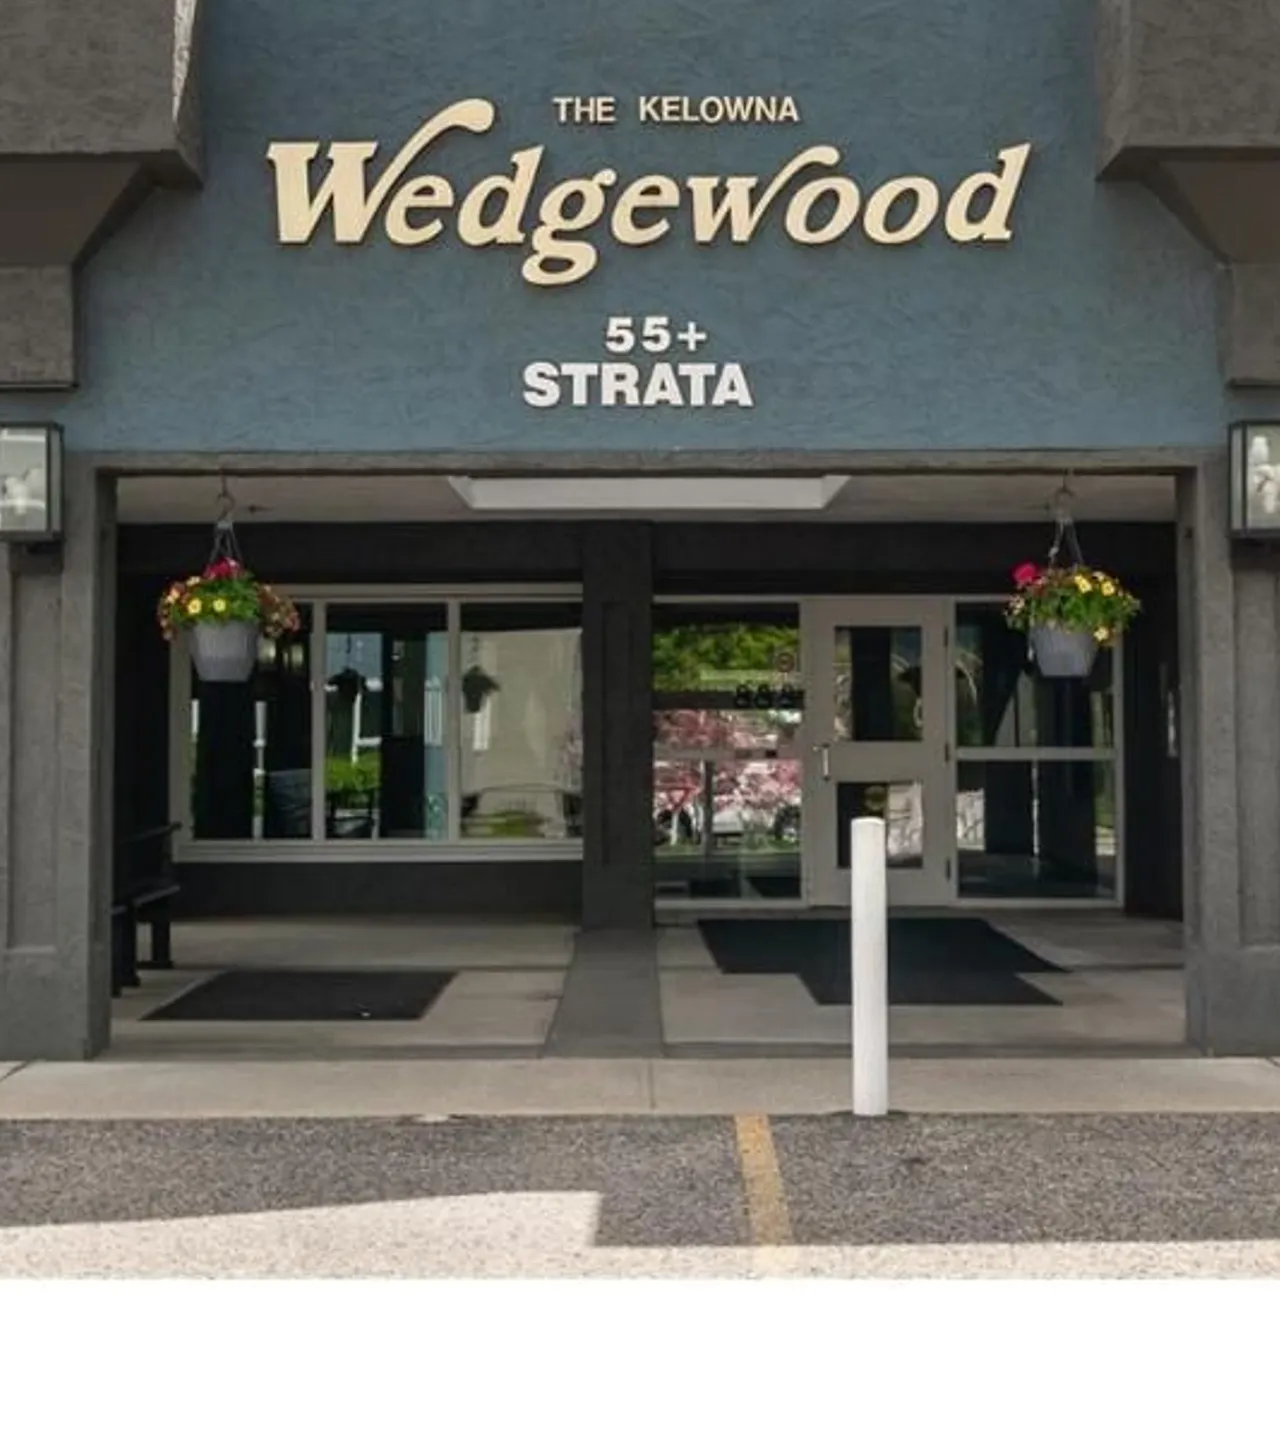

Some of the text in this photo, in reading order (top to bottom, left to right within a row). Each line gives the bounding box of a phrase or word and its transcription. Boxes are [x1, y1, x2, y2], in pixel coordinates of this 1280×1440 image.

[553, 95, 800, 124] THE KELOWNA
[266, 98, 1033, 287] Wedgewood
[604, 316, 708, 355] 55+
[522, 361, 754, 408] STRATA
